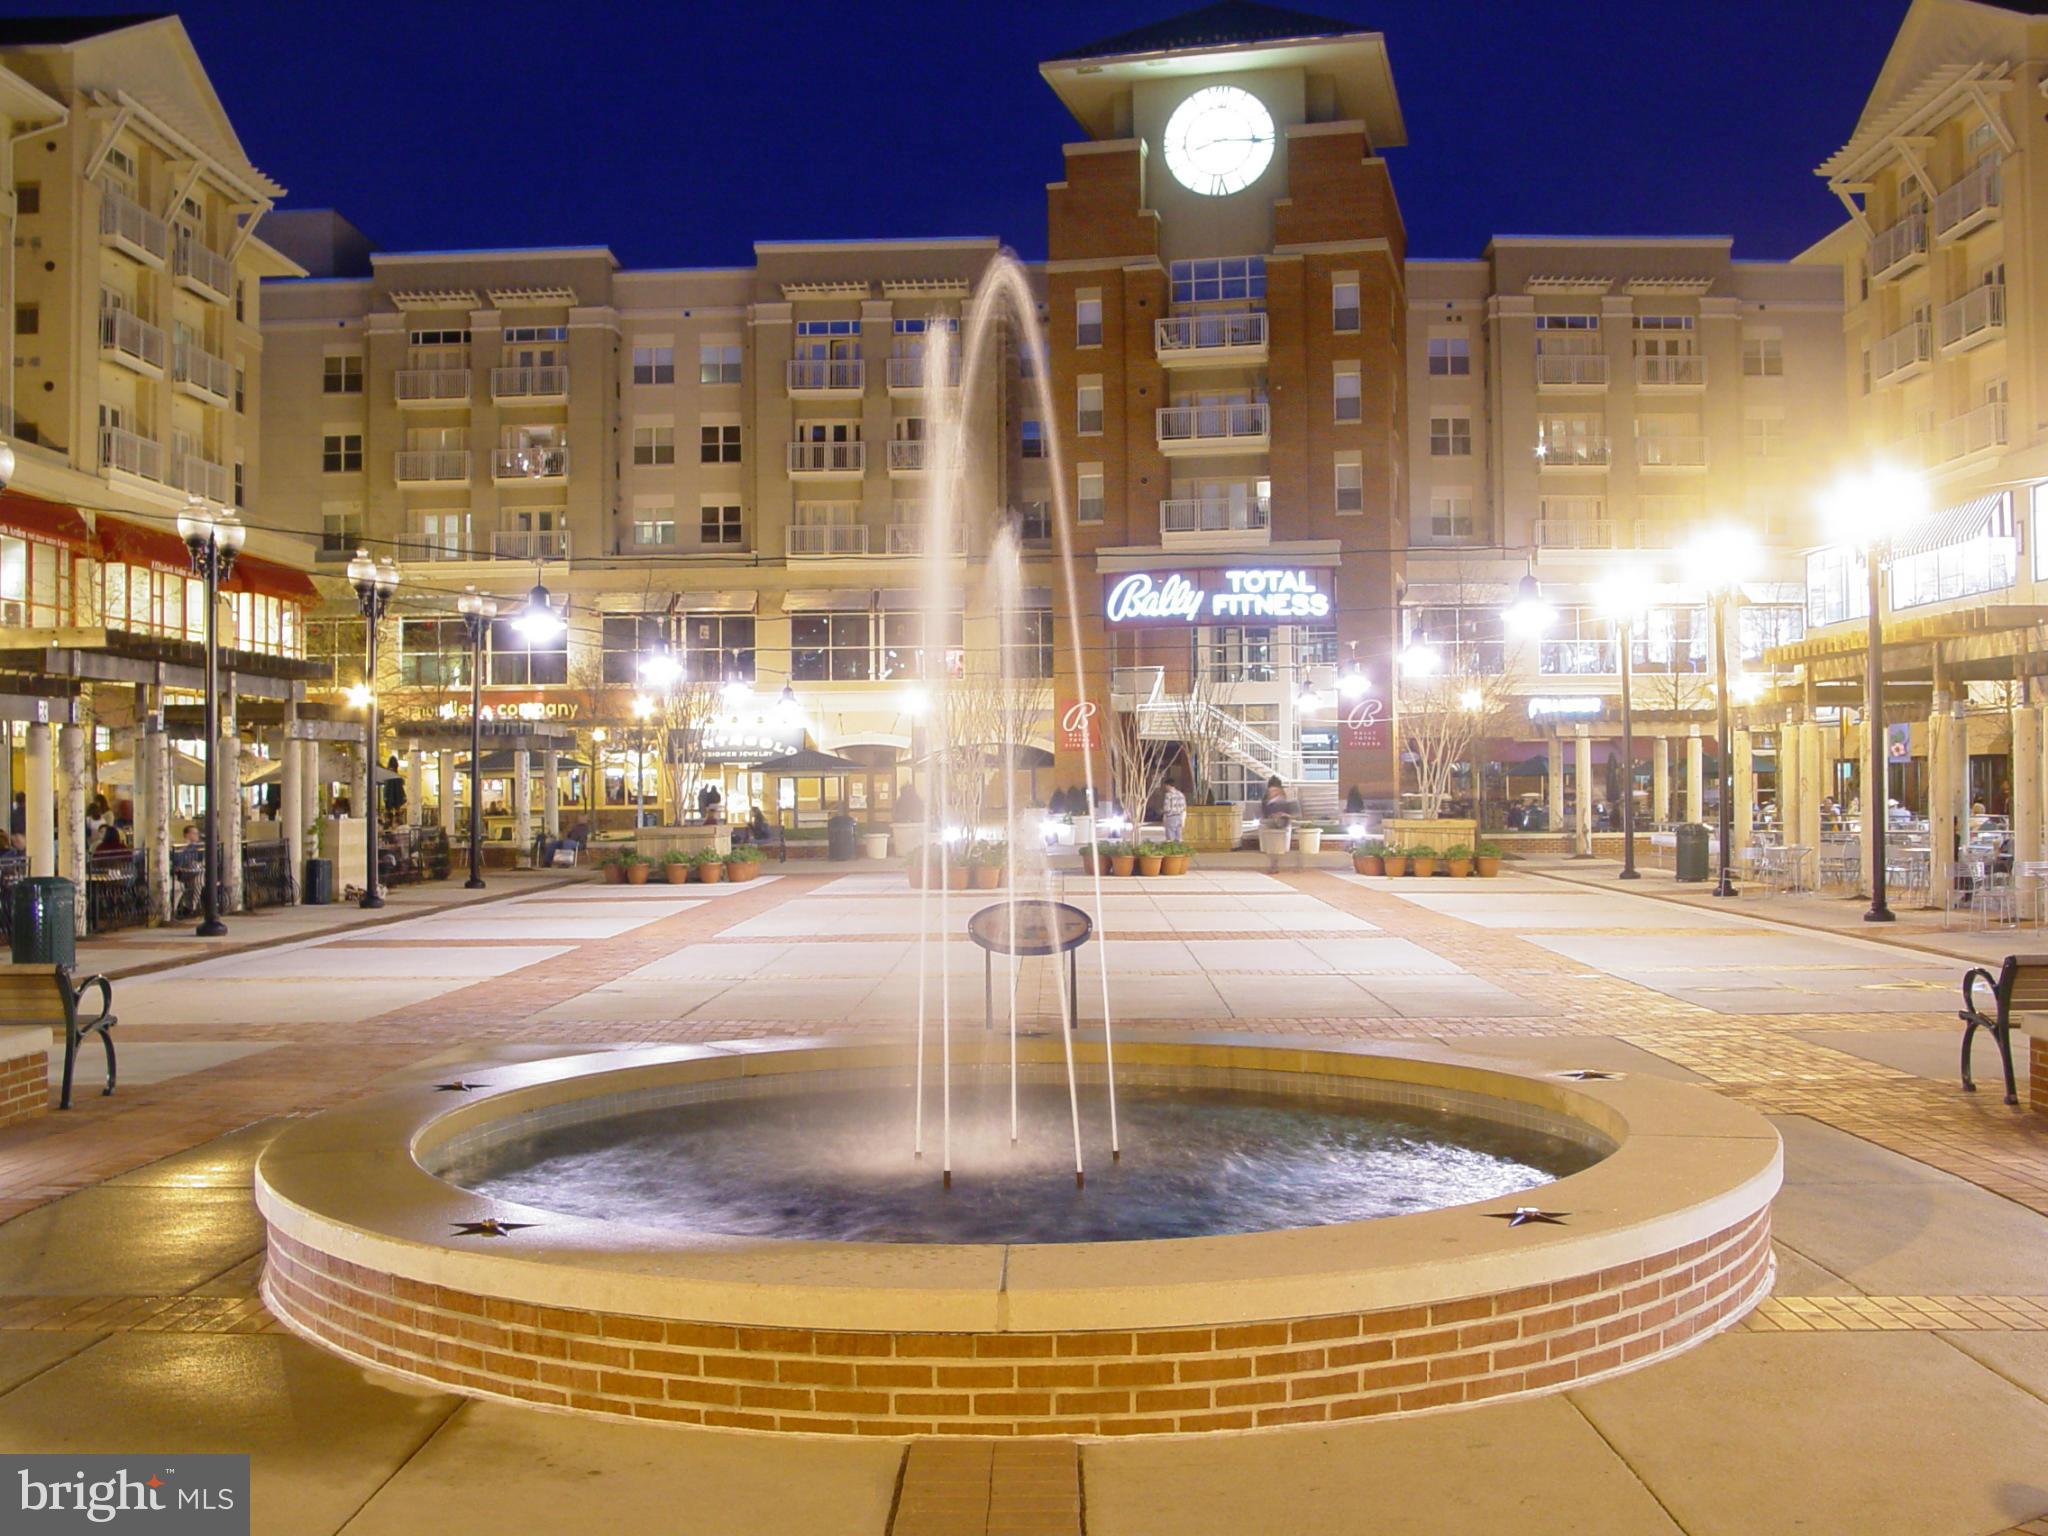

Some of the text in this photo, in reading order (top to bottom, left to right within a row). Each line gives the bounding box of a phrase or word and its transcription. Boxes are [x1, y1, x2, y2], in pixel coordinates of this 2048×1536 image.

[1225, 570, 1316, 593] TOTAL
[1107, 573, 1205, 622] Bally
[1212, 594, 1329, 617] FITNESS
